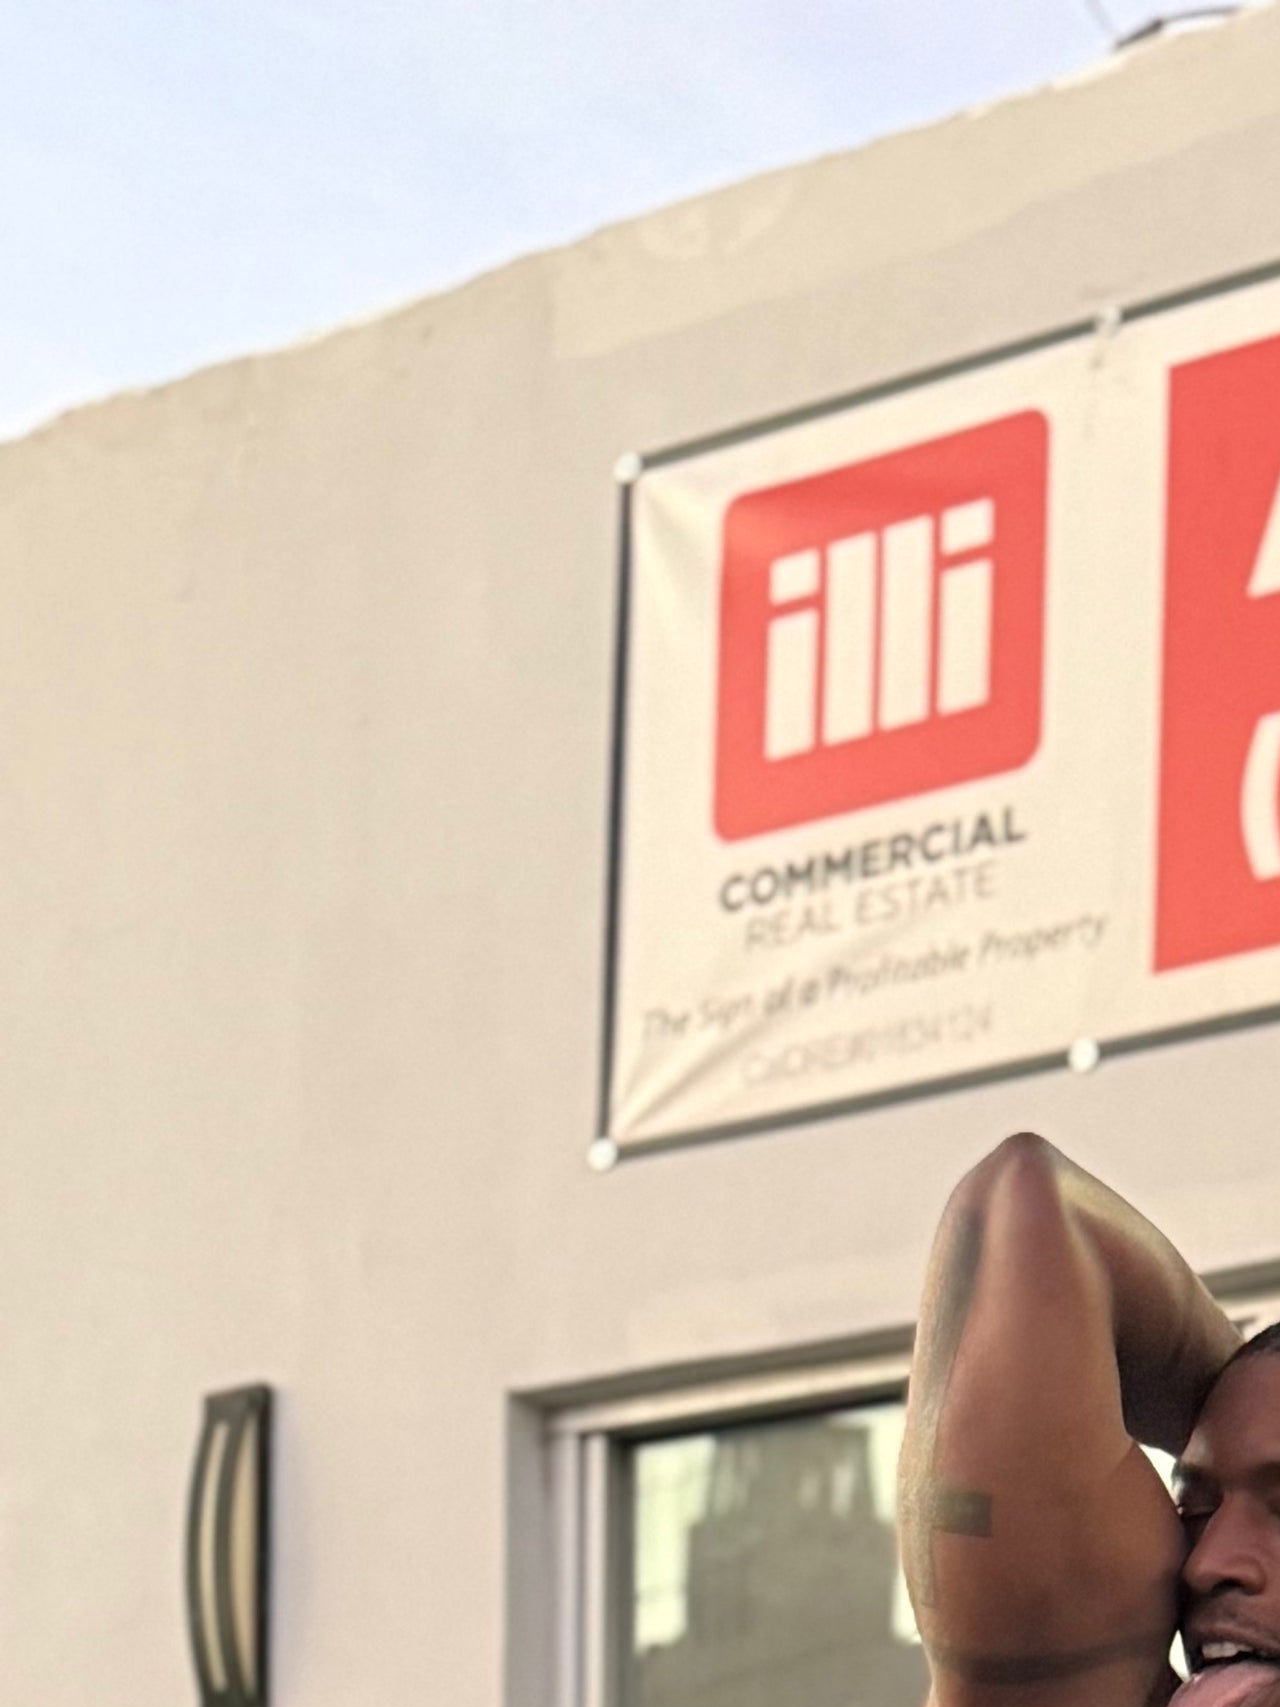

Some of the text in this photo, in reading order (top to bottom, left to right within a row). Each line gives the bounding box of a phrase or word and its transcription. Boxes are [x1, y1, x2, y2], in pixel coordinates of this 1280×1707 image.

[765, 499, 993, 760] illi
[719, 806, 1026, 912] COMMERCIAL
[745, 859, 999, 951] REAL ESTATE
[643, 1007, 692, 1050] The
[976, 913, 1109, 966] Property
